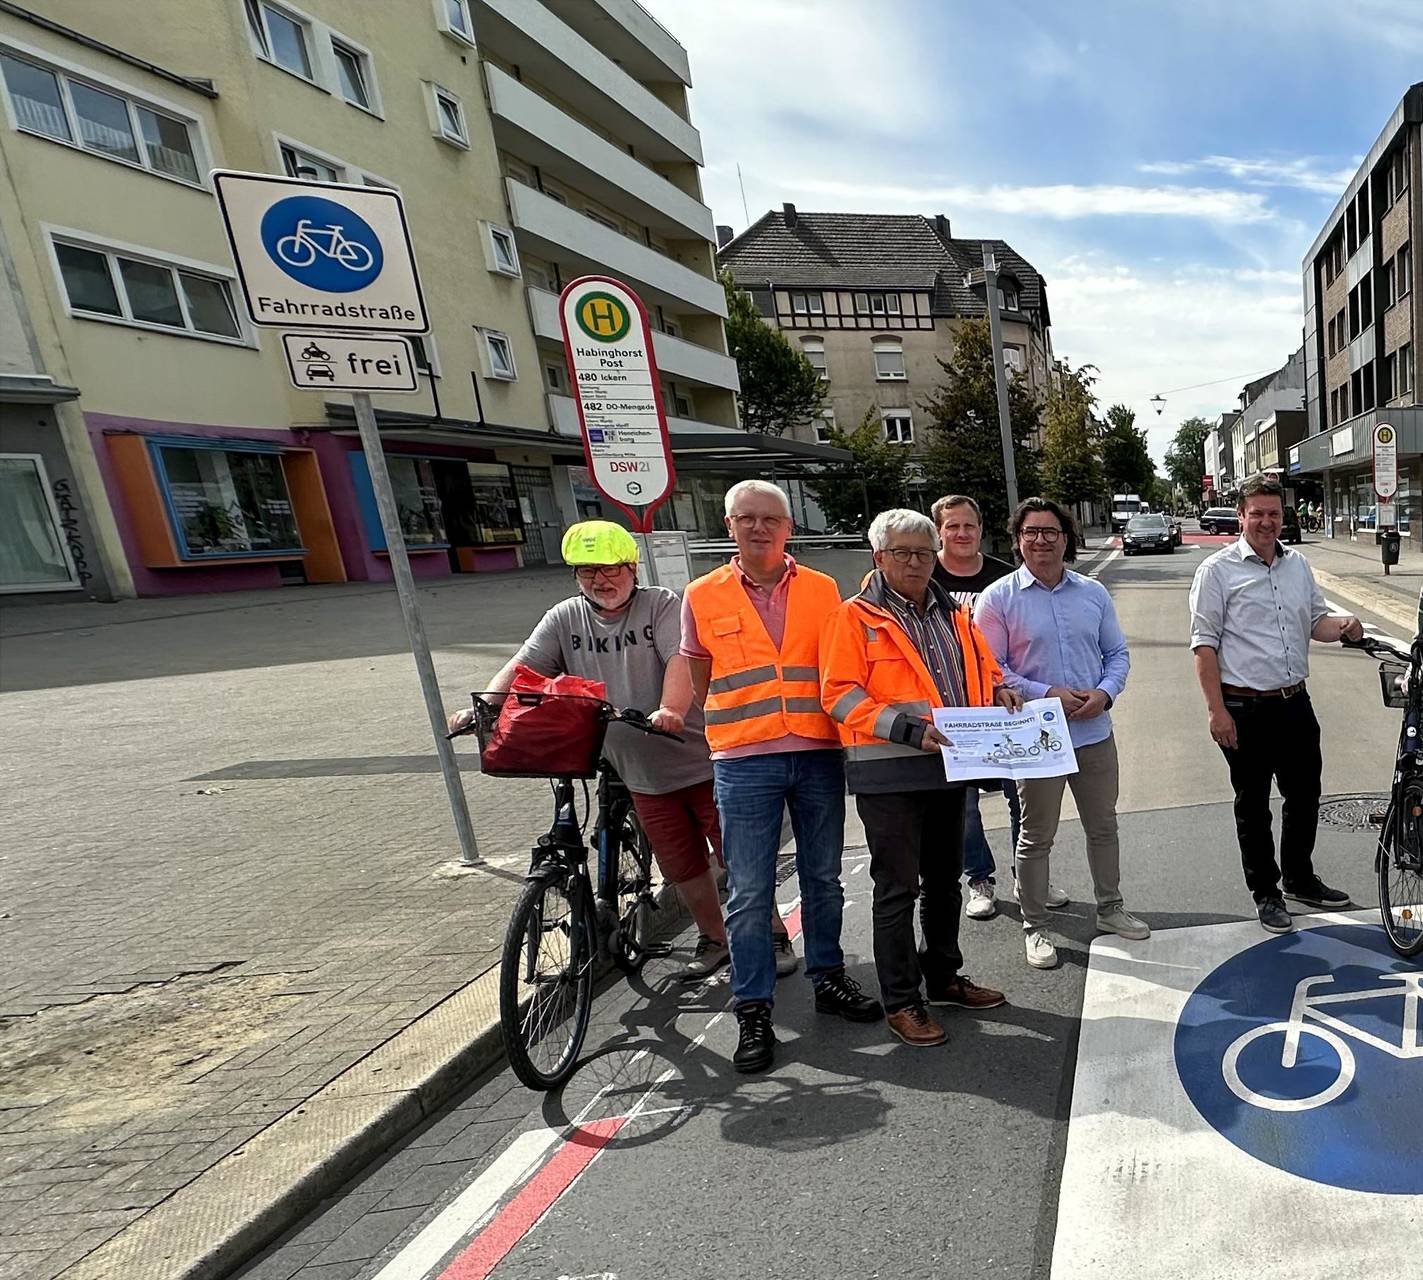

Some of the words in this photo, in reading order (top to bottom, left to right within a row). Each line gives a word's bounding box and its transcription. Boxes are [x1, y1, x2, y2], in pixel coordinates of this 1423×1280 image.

[258, 297, 416, 321] Fahrradstraße
[590, 303, 616, 331] H
[576, 348, 643, 359] Habinghorst
[347, 352, 402, 376] frei
[600, 358, 625, 367] Post
[578, 373, 598, 382] 480
[583, 402, 603, 411] 482
[610, 461, 651, 473] DSW21
[571, 625, 654, 653] BIKING
